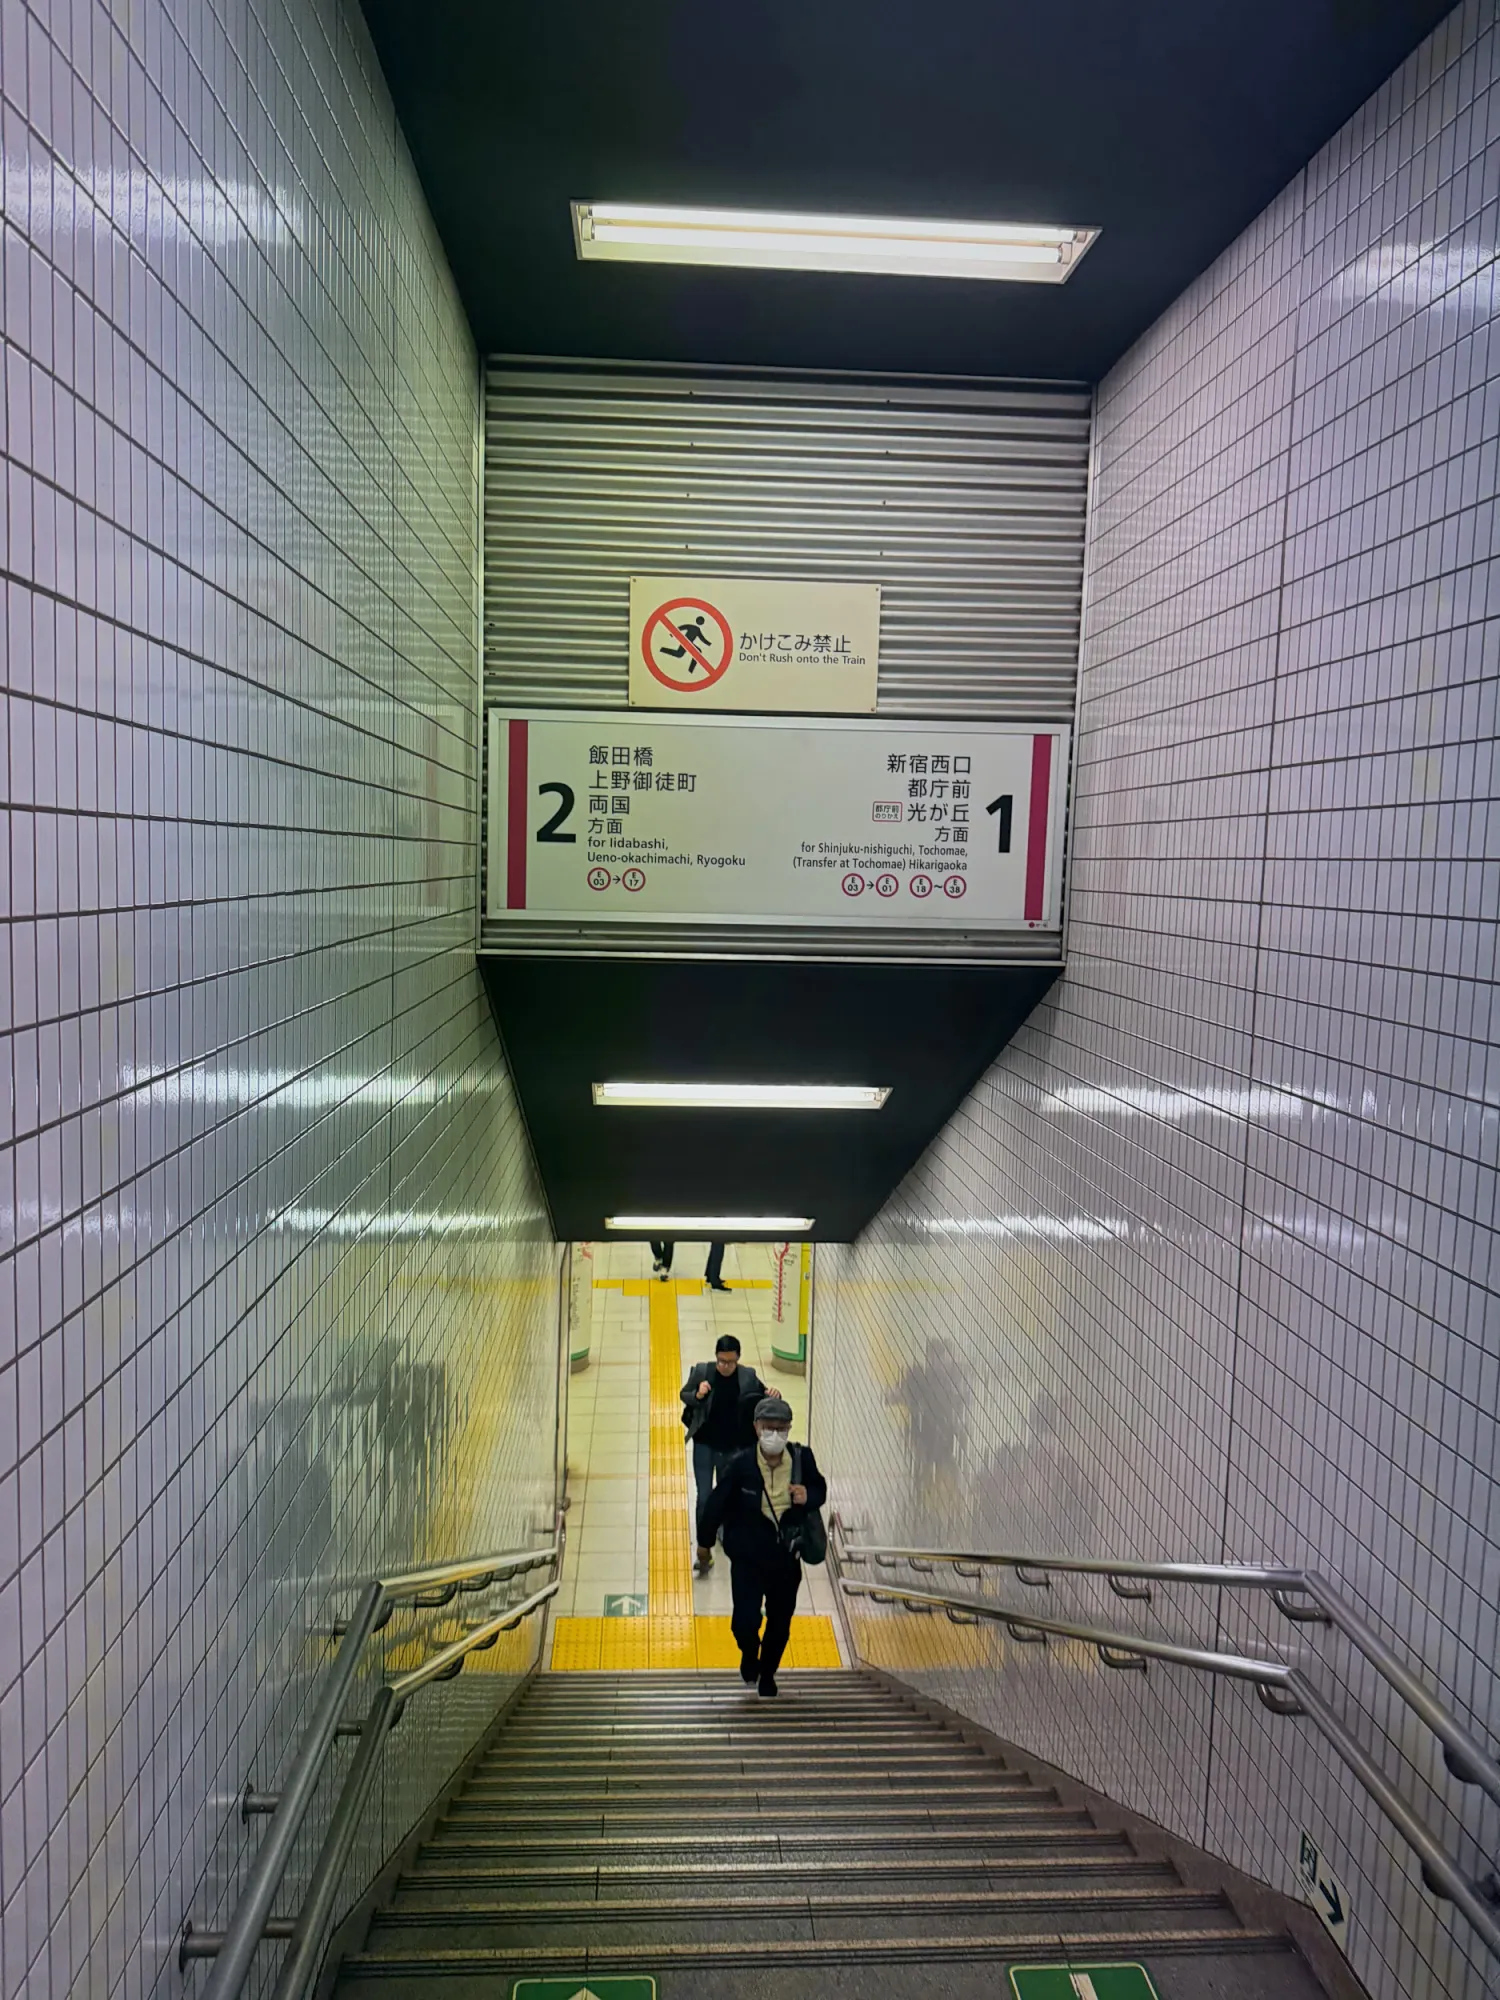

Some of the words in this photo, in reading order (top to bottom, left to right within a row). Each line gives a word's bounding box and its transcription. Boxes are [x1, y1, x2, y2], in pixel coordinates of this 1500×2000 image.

[740, 632, 851, 653] かけこみ禁止
[739, 652, 766, 662] Don't
[769, 653, 793, 663] Rush
[796, 656, 820, 664] onto
[823, 655, 839, 664] the
[842, 655, 866, 665] Train
[589, 745, 653, 767] 飯田橋
[887, 753, 971, 774] 新宿西口
[588, 770, 697, 793] 上野御徒町
[908, 778, 971, 799] 都庁前
[536, 782, 576, 843] 2
[589, 794, 630, 815] 両国
[875, 804, 900, 813] 都庁前
[907, 803, 970, 822] 光が丘
[588, 818, 623, 835] 方面
[986, 794, 1013, 853] 1
[588, 836, 606, 848] for
[610, 838, 669, 850] Iidabashi,
[934, 826, 969, 843] 方面
[801, 842, 816, 853] for
[818, 842, 915, 857] Shinjuku-nishiguchi,
[919, 845, 968, 857] Tochomae,
[587, 852, 693, 866] Ueno-okachimachi,
[697, 855, 746, 868] Ryogoku
[793, 856, 837, 869] (Transfer
[840, 859, 850, 868] at
[852, 858, 906, 871] Tochomae)
[909, 860, 967, 873] Hikarigaoka
[593, 878, 605, 886] 03
[847, 884, 859, 892] 03
[950, 886, 961, 894] 38
